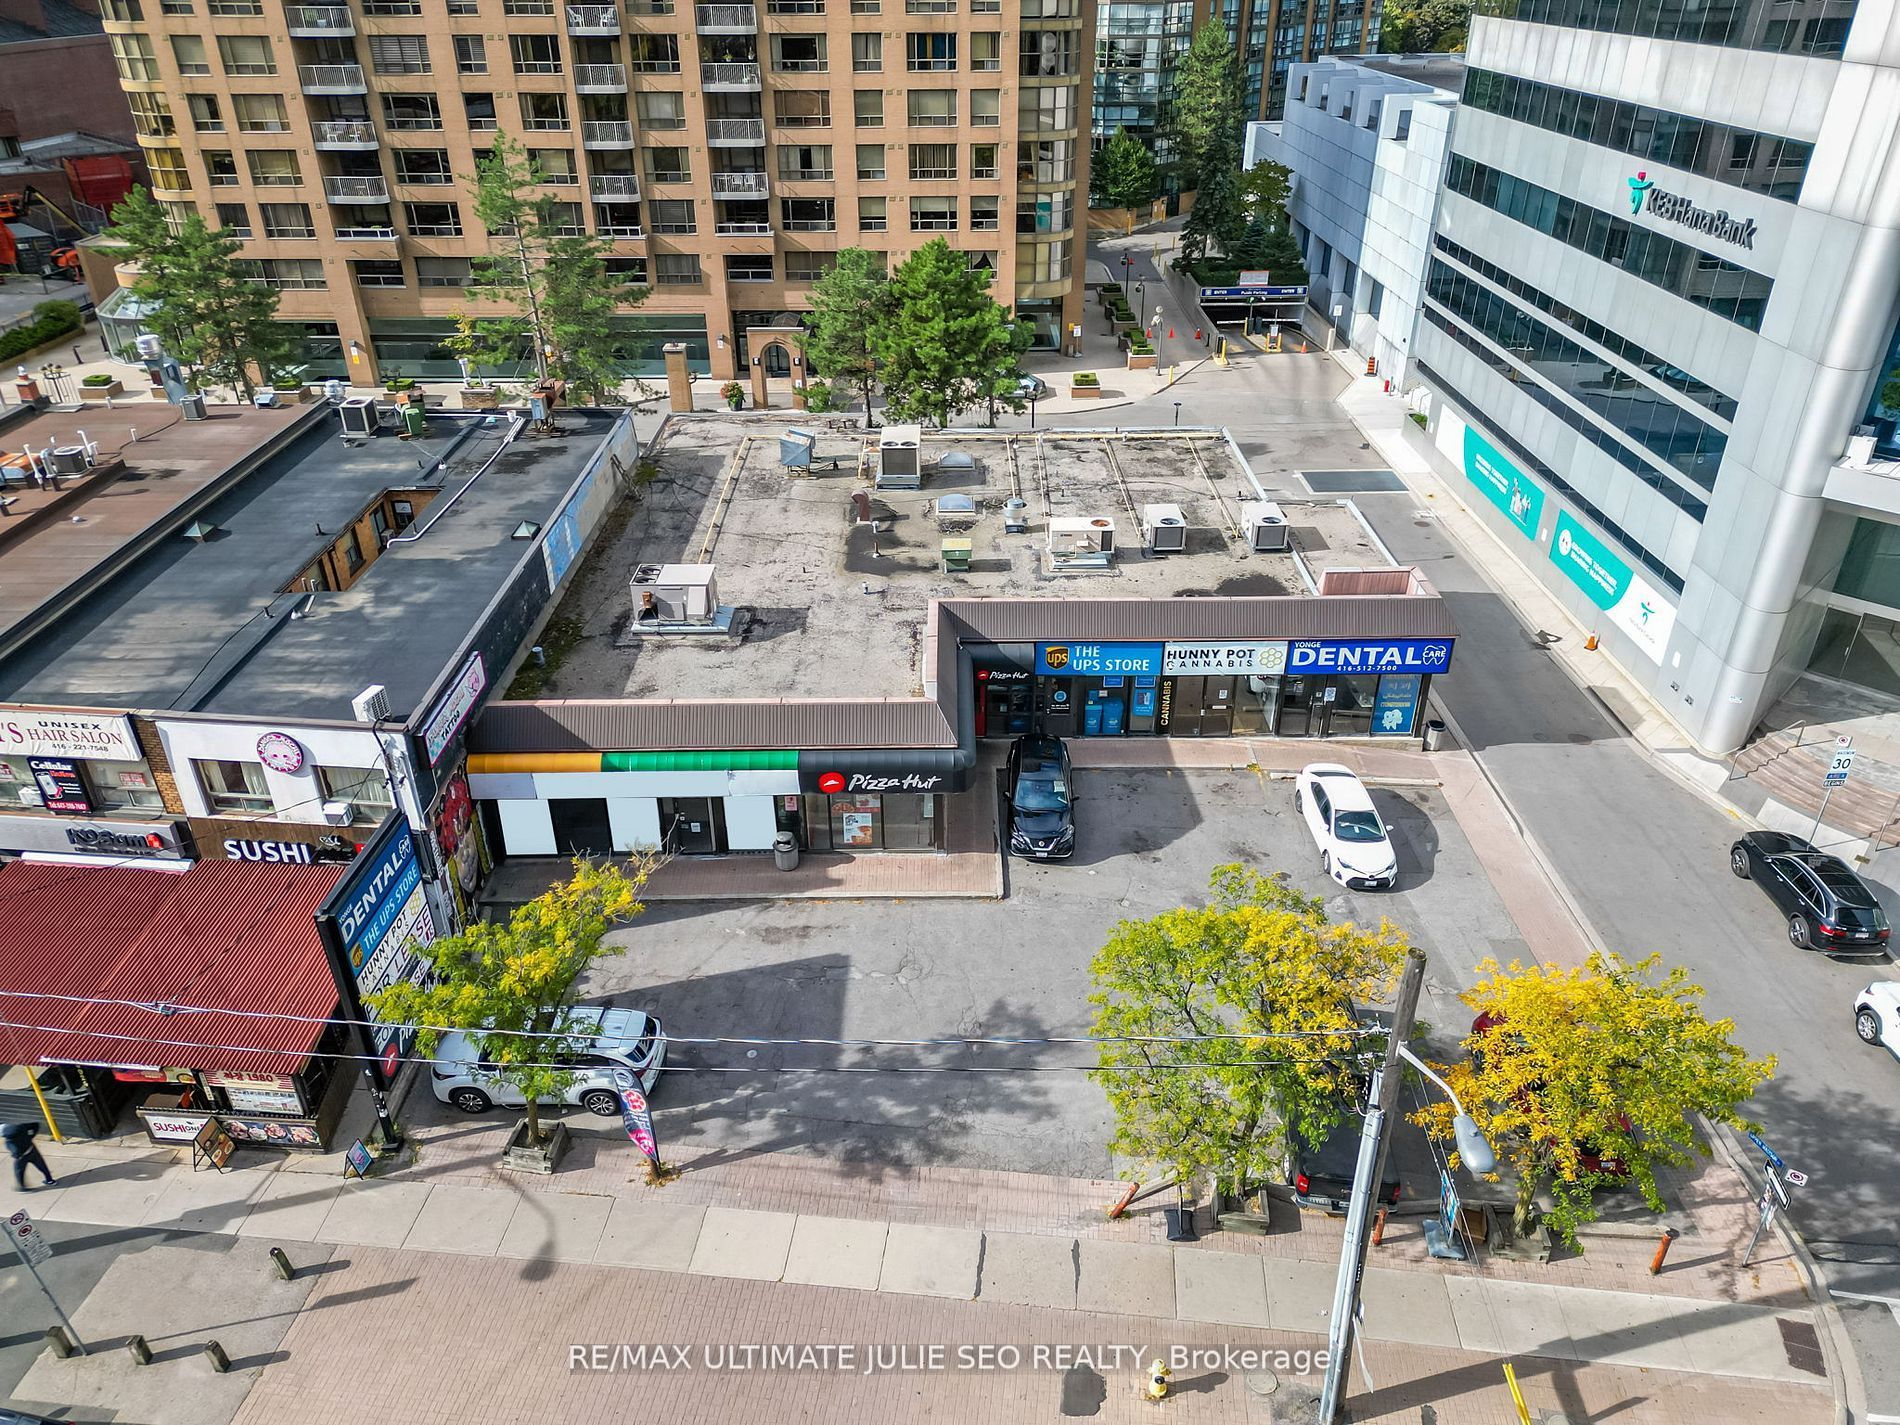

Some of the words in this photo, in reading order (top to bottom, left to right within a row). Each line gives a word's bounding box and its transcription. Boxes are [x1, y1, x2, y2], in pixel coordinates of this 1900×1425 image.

[1711, 210, 1757, 250] Bank
[1047, 651, 1068, 667] ups
[1074, 645, 1100, 658] THE
[1167, 649, 1221, 660] HUNNY
[1226, 649, 1256, 659] POT
[1292, 646, 1421, 666] DENTAL
[1423, 650, 1446, 658] CARE
[1072, 659, 1101, 671] UPS
[1105, 659, 1150, 671] STORE
[1166, 660, 1254, 669] CANNABIS
[989, 671, 1012, 680] Pizza
[1160, 681, 1172, 726] CANNABIS
[0, 722, 24, 744] 'S
[38, 720, 102, 731] UNISEX
[26, 728, 70, 743] HAIR
[70, 730, 124, 745] SALON
[1832, 758, 1851, 769] 30
[849, 773, 901, 791] Pizza
[902, 773, 942, 790] Hut
[223, 839, 311, 865] SUSHI
[341, 852, 403, 944] DENTAL
[364, 922, 381, 950] THE
[379, 902, 397, 927] UPS
[395, 864, 418, 904] STORE
[361, 936, 390, 986] HUNNY
[391, 909, 407, 938] POT
[248, 1071, 273, 1083] 1980
[153, 1121, 186, 1132] SUSHI
